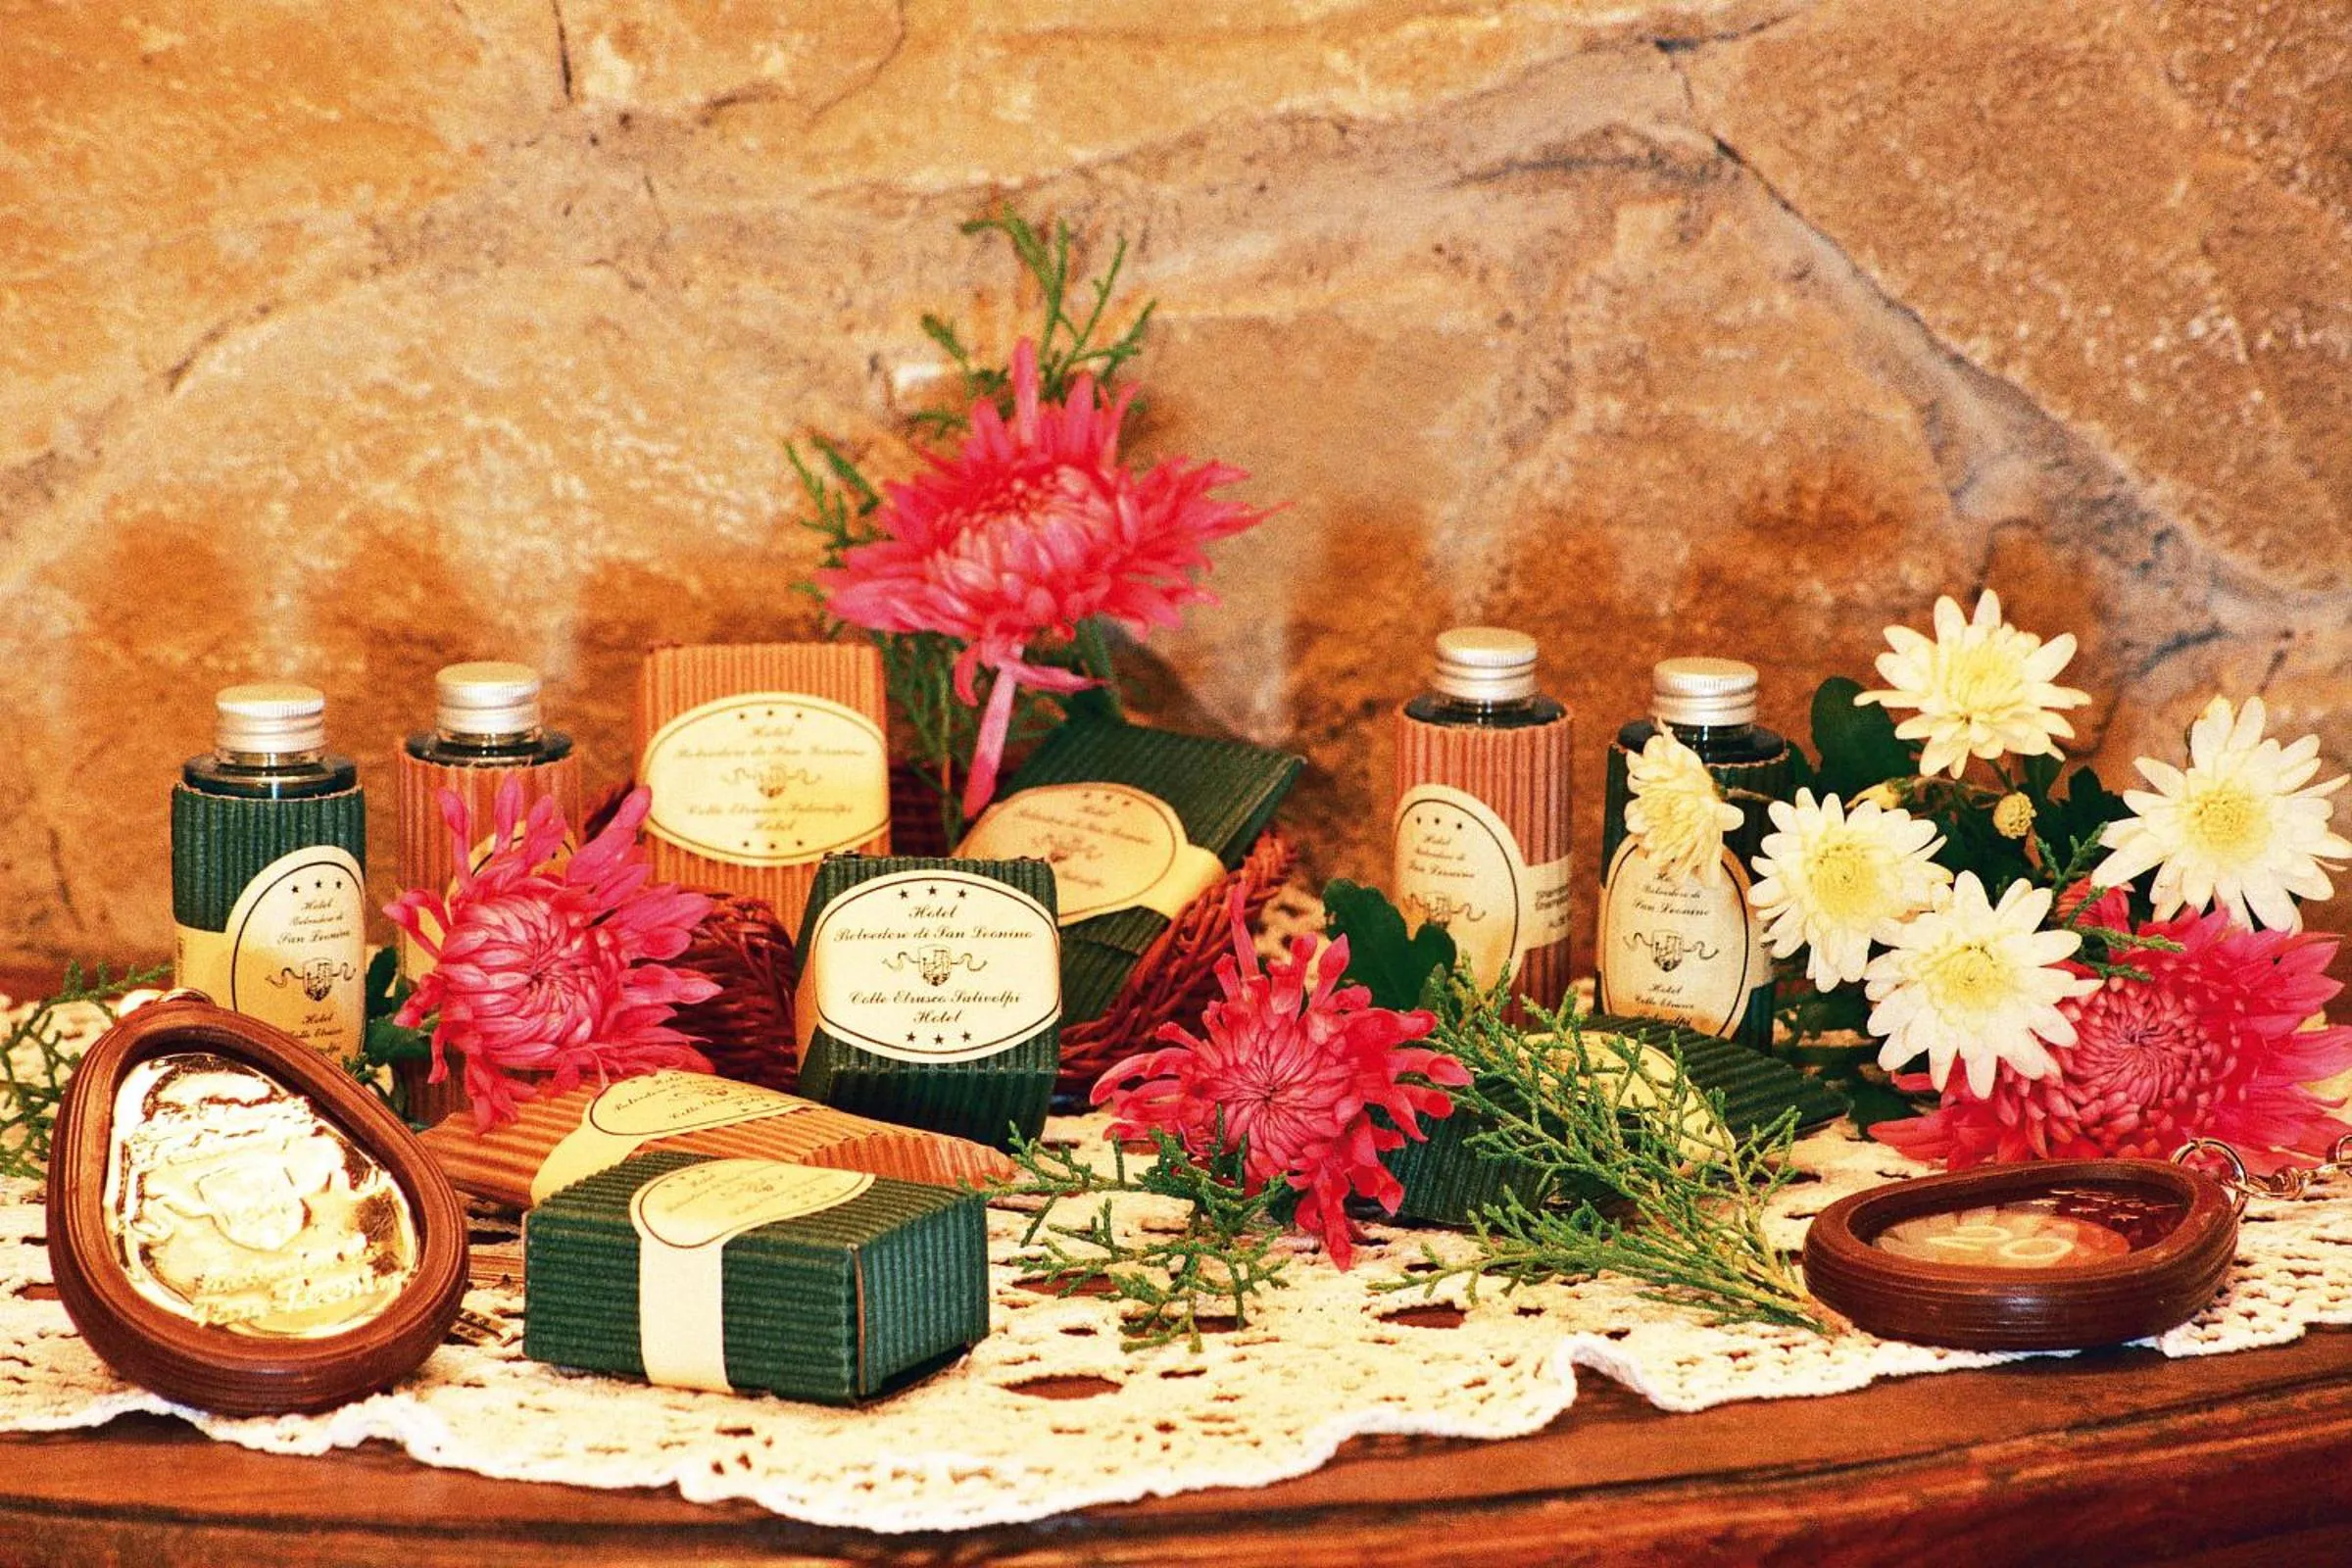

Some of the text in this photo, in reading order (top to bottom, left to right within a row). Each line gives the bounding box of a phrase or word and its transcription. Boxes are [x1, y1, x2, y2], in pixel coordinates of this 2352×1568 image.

[907, 905, 957, 918] Hotel
[833, 927, 906, 942] Belvedere
[912, 926, 929, 939] di
[933, 924, 965, 939] San
[849, 990, 887, 1004] Colle
[893, 990, 947, 1004] Etrusco
[912, 1010, 963, 1024] Hotel
